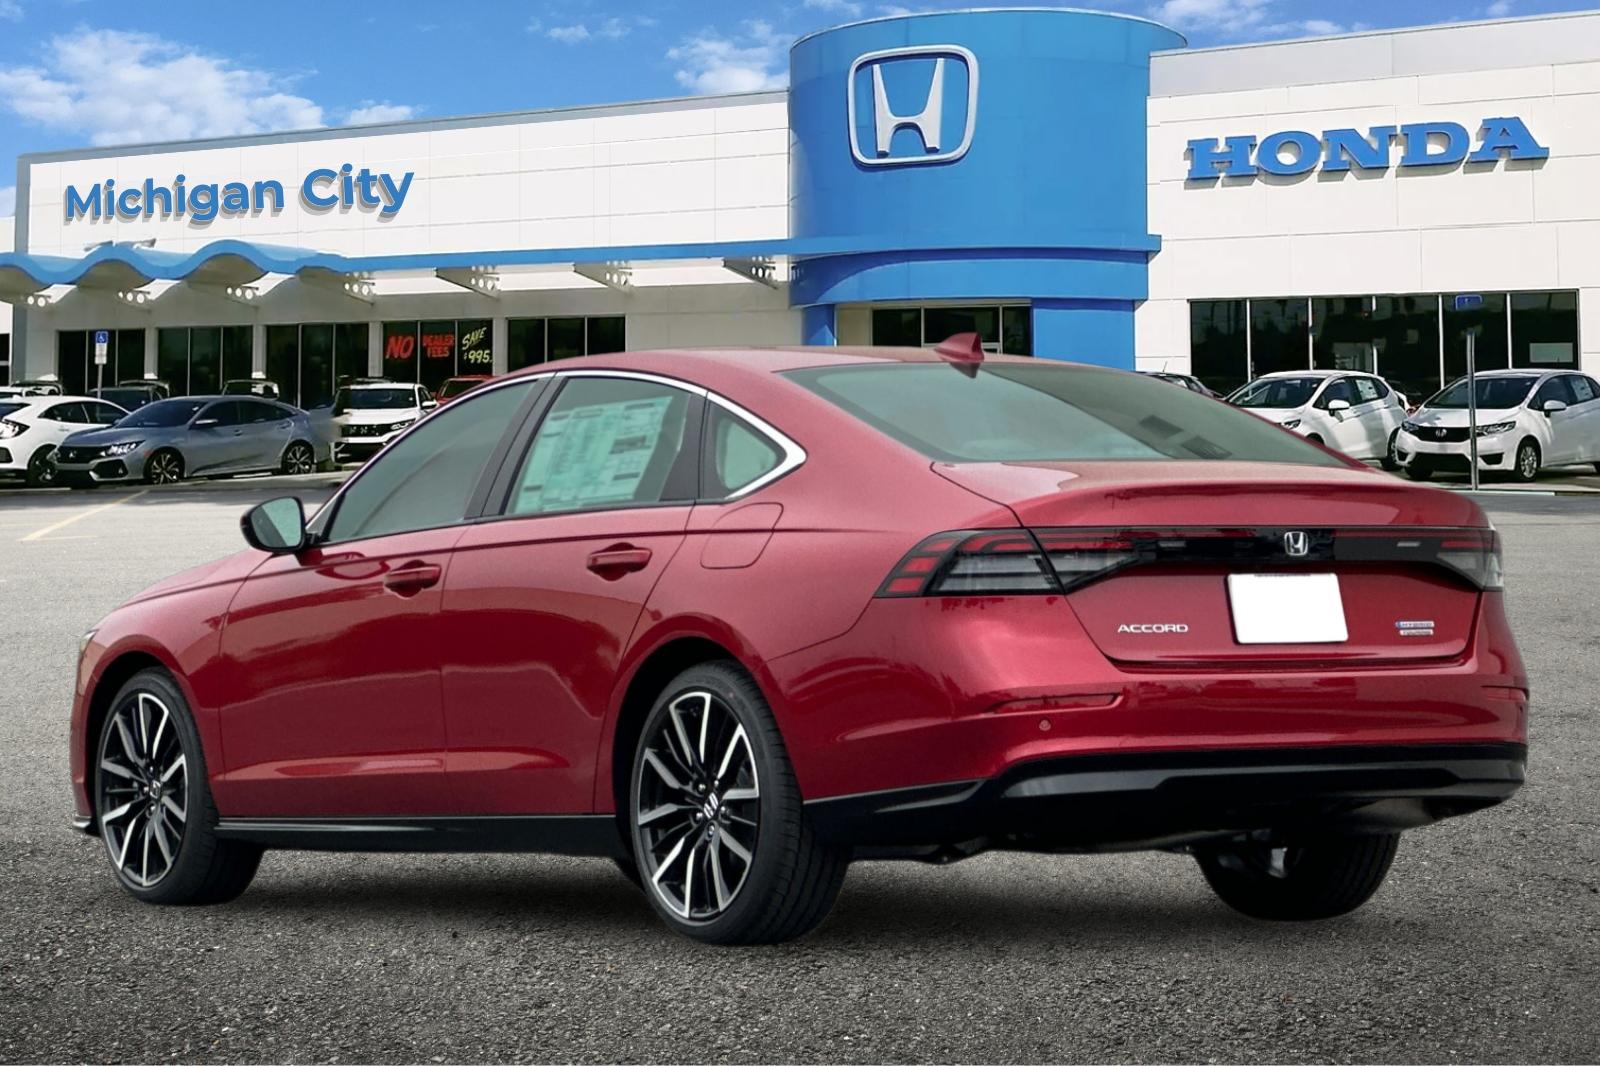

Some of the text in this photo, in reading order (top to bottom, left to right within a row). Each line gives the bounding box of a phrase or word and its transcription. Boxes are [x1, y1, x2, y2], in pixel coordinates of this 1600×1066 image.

[1185, 116, 1550, 184] HONDA
[65, 163, 415, 224] Michigan City
[384, 335, 415, 359] NO
[462, 327, 488, 350] SAVE
[1117, 624, 1189, 633] ACCORD
